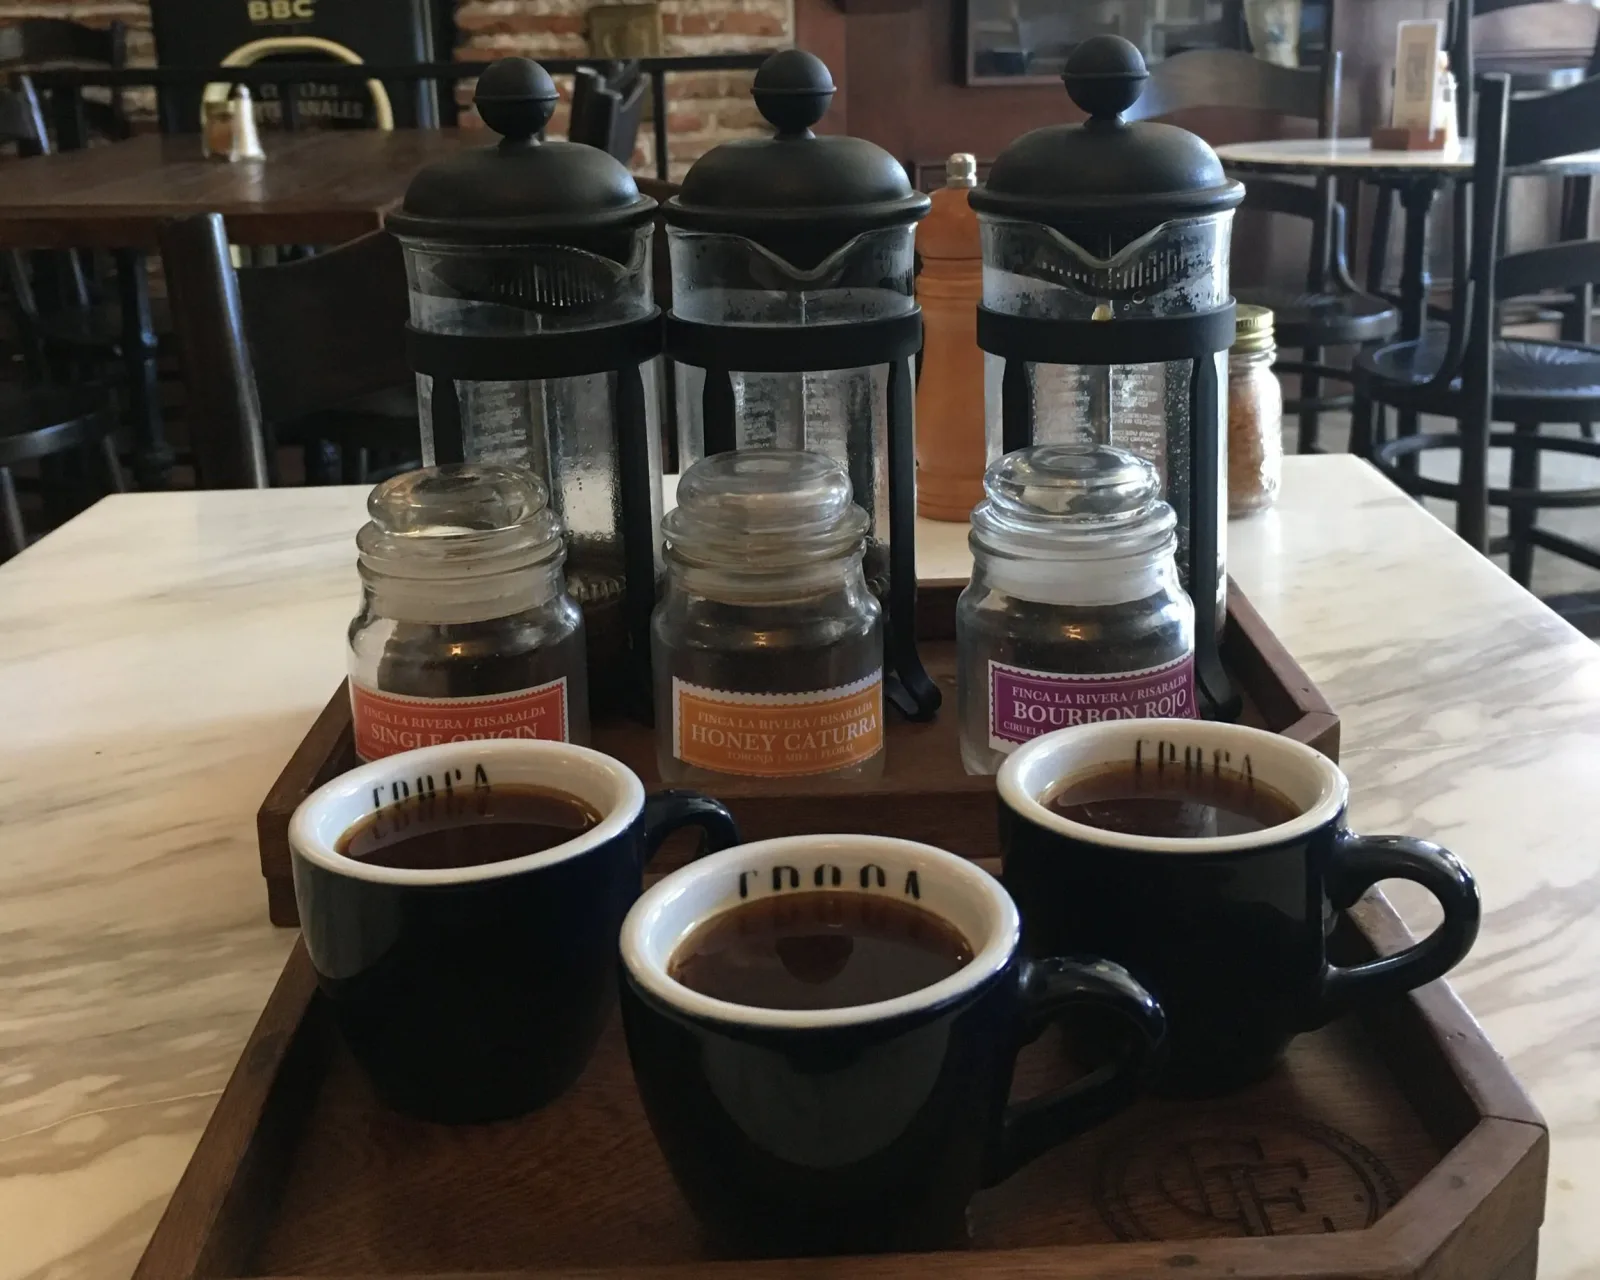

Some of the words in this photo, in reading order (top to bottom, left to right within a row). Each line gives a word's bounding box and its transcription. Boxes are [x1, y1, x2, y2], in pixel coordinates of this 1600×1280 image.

[248, 0, 316, 20] BBC
[1012, 686, 1051, 702] FINCA
[1055, 693, 1072, 704] LA
[1076, 692, 1127, 704] RIVERA
[1138, 674, 1188, 700] RISARALDA
[364, 705, 390, 724] FINCA
[394, 714, 408, 726] LA
[412, 717, 463, 730] RIVERA
[474, 706, 547, 729] RISARALDA
[698, 711, 735, 728] FINCA
[739, 718, 754, 729] LA
[759, 717, 810, 731] RIVERA
[820, 700, 873, 727] RISARALDA
[1013, 700, 1139, 727] BOURBON
[1145, 688, 1186, 718] ROJO
[371, 723, 443, 749] SINGLE
[691, 723, 776, 752] HONEY
[784, 714, 877, 750] CATURRA
[1003, 720, 1045, 735] CIRUELA
